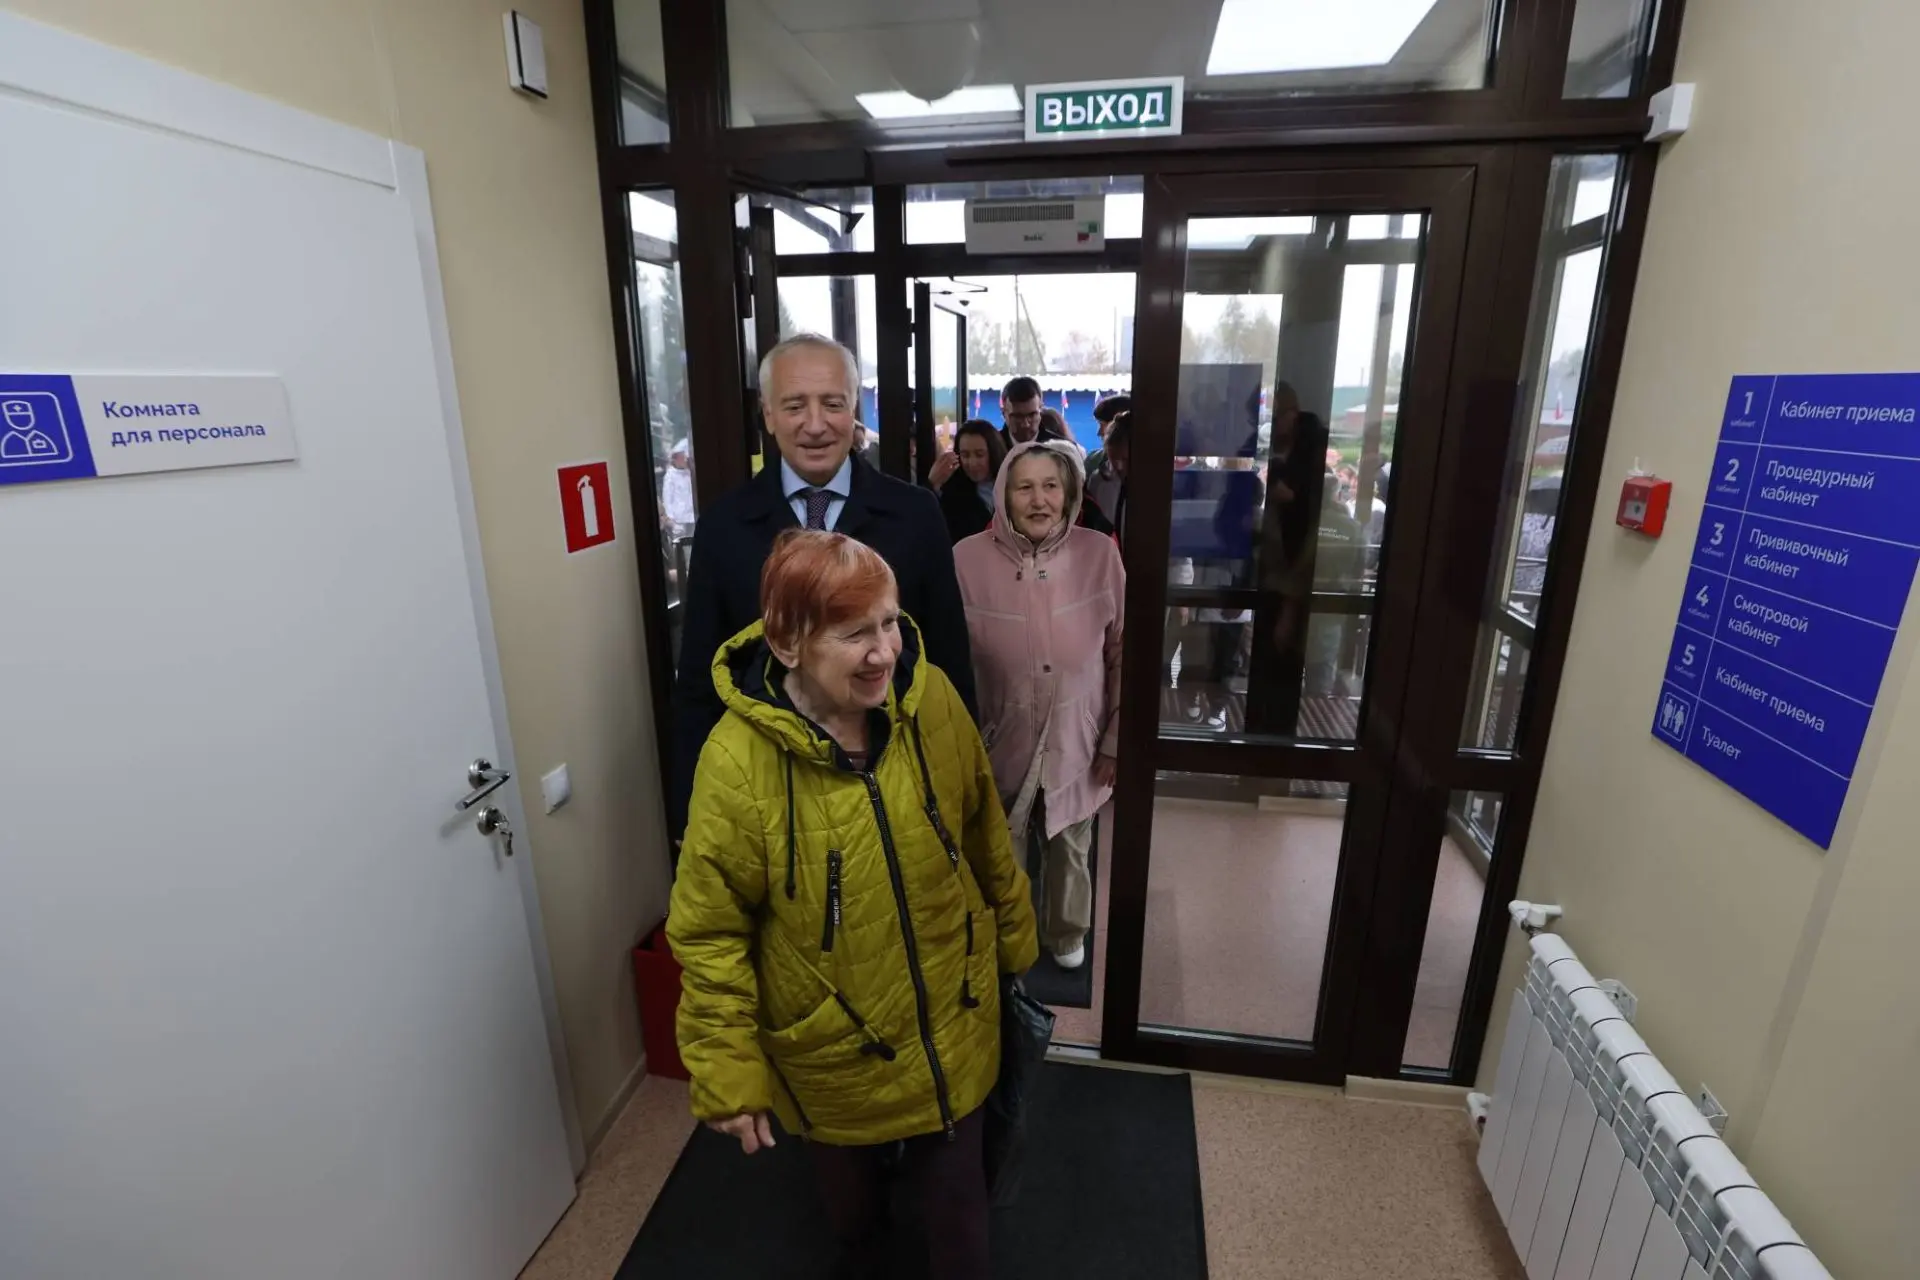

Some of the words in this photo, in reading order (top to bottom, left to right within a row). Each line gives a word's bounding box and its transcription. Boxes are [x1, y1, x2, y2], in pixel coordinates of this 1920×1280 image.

[1043, 91, 1165, 127] ВЫХОД
[103, 401, 200, 418] Комната
[1744, 391, 1754, 415] 1
[1780, 400, 1844, 419] Кабинет
[1846, 407, 1916, 425] приема
[111, 429, 152, 448] для
[159, 424, 266, 445] персонала
[1725, 458, 1739, 482] 2
[1766, 460, 1875, 490] Процедурный
[1761, 485, 1819, 508] кабинет
[1710, 522, 1724, 545] 3
[1749, 528, 1850, 567] Прививочный
[1743, 553, 1800, 579] кабинет
[1695, 585, 1709, 607] 4
[1734, 594, 1809, 632] Смотровой
[1728, 617, 1781, 647] кабинет
[1682, 643, 1696, 665] 5
[1716, 666, 1768, 703] Кабинет
[1769, 695, 1826, 733] приема
[1702, 726, 1741, 760] Туалет
